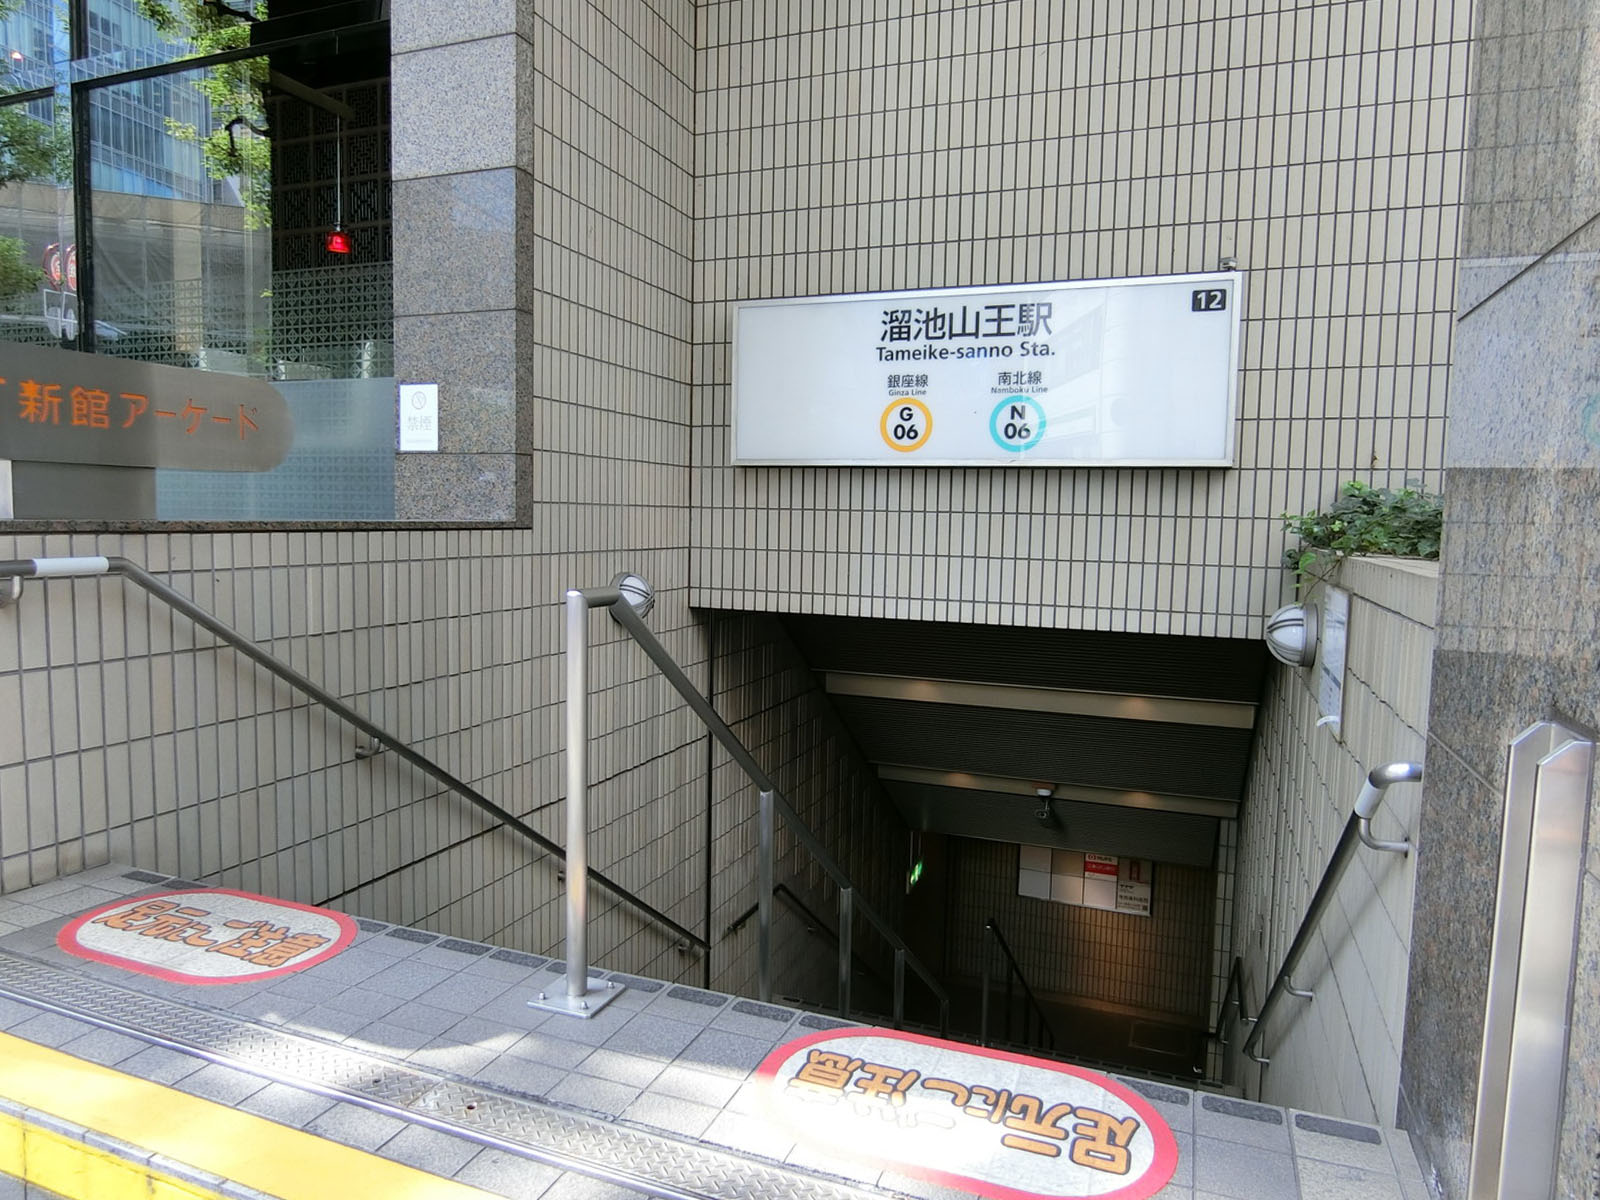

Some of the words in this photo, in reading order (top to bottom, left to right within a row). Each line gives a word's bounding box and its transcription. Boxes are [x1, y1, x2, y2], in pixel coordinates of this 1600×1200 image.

[1197, 291, 1222, 309] 12
[880, 302, 1053, 343] 溜池山王駅
[876, 344, 1013, 361] Tameike-sanno
[1020, 341, 1055, 357] Sta.
[887, 374, 929, 388] 銀座線
[998, 370, 1042, 385] 南北線
[991, 386, 1030, 394] Namboku
[0, 377, 259, 441] 新館アーケード
[899, 406, 914, 422] G
[1010, 405, 1026, 420] N
[893, 424, 919, 440] 06
[1004, 423, 1031, 439] 06
[91, 899, 332, 967] 足元にご注意
[787, 1048, 1140, 1176] 足元にご注意
